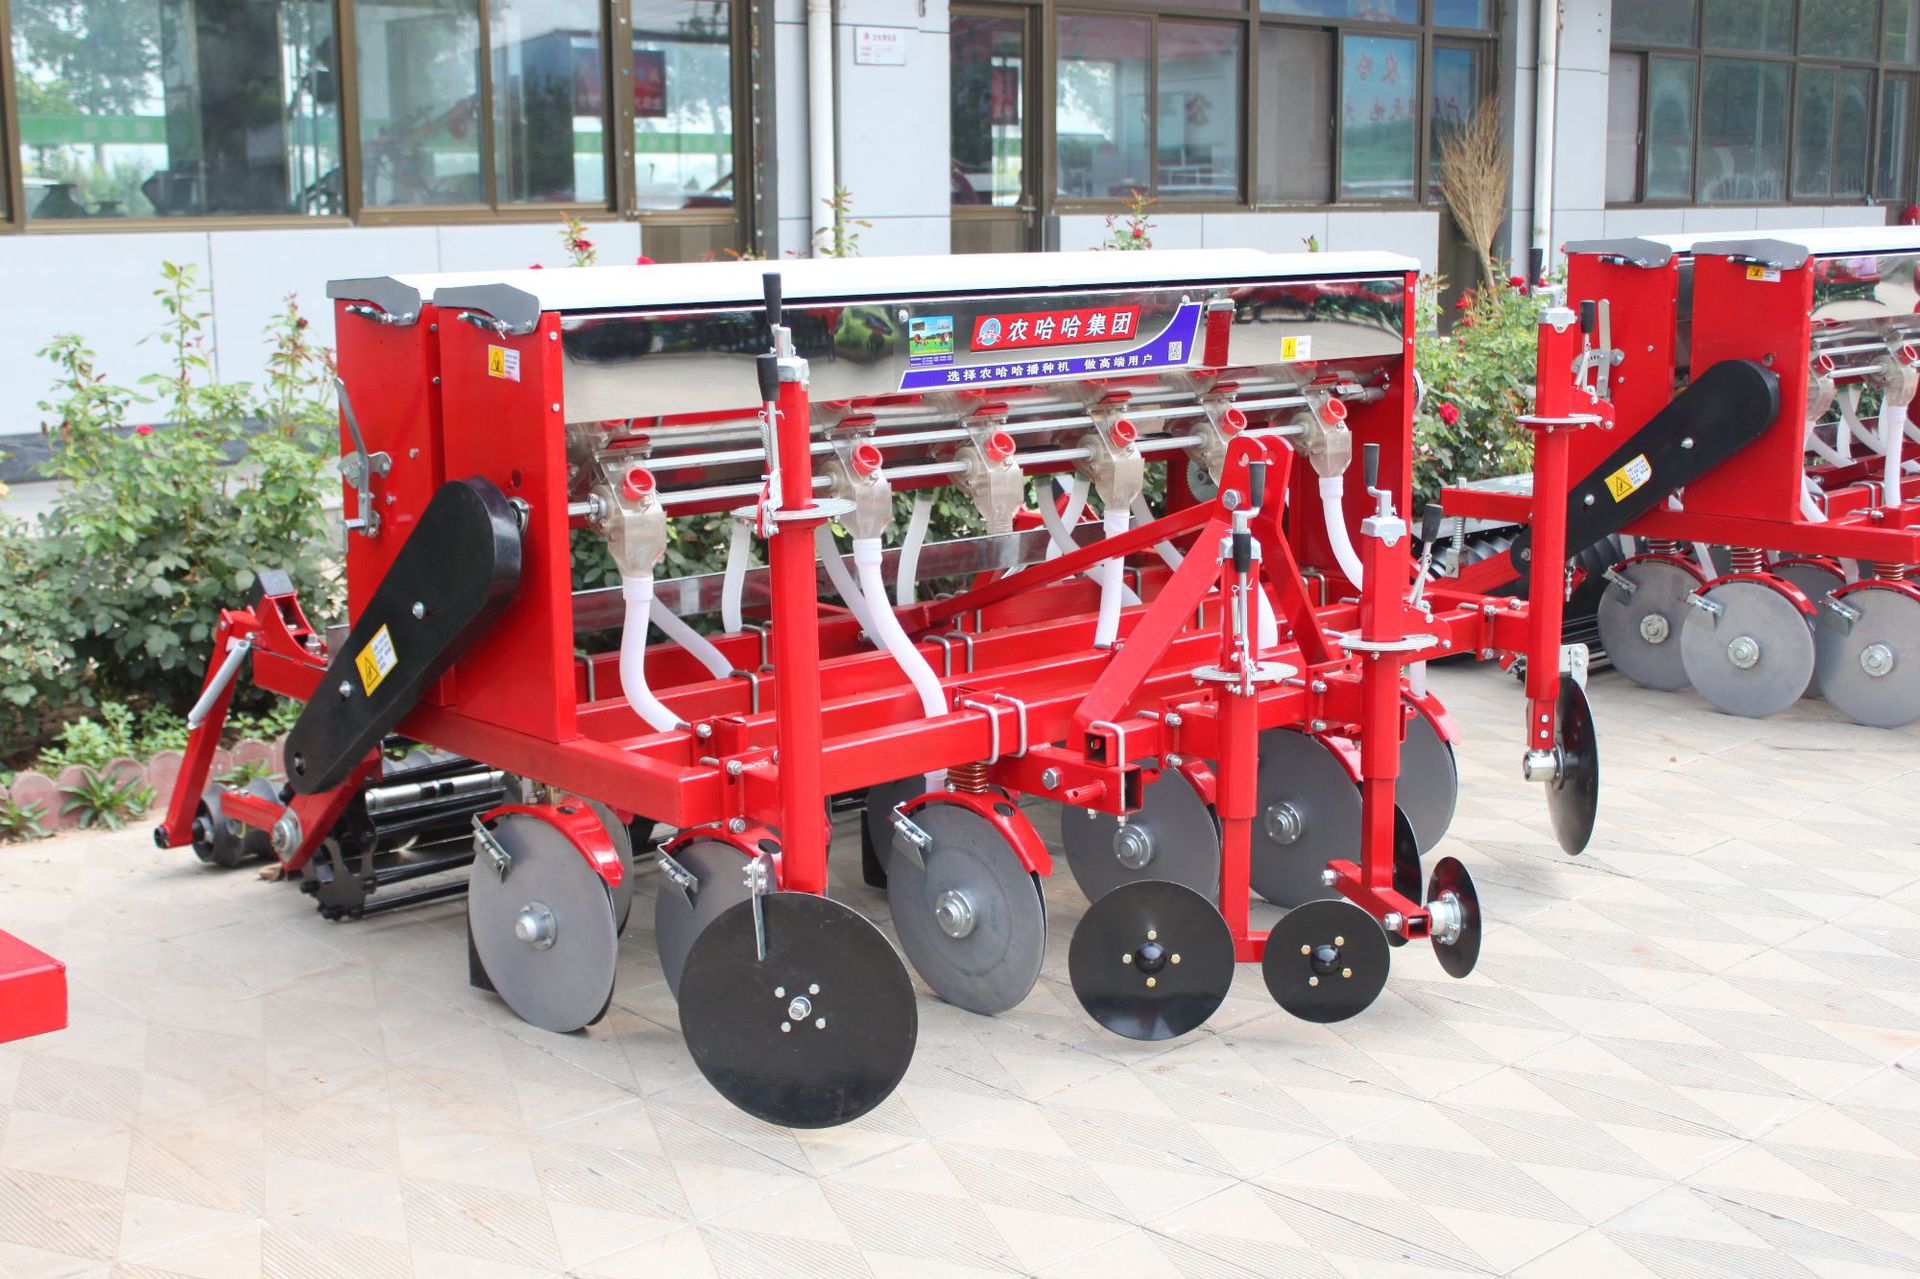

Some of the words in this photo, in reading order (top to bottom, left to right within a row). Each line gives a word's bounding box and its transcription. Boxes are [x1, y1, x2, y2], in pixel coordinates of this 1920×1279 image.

[1007, 312, 1132, 342] 农哈哈集团
[946, 361, 1070, 382] 选择农哈哈播种机
[1083, 354, 1153, 371] 做高端用户
